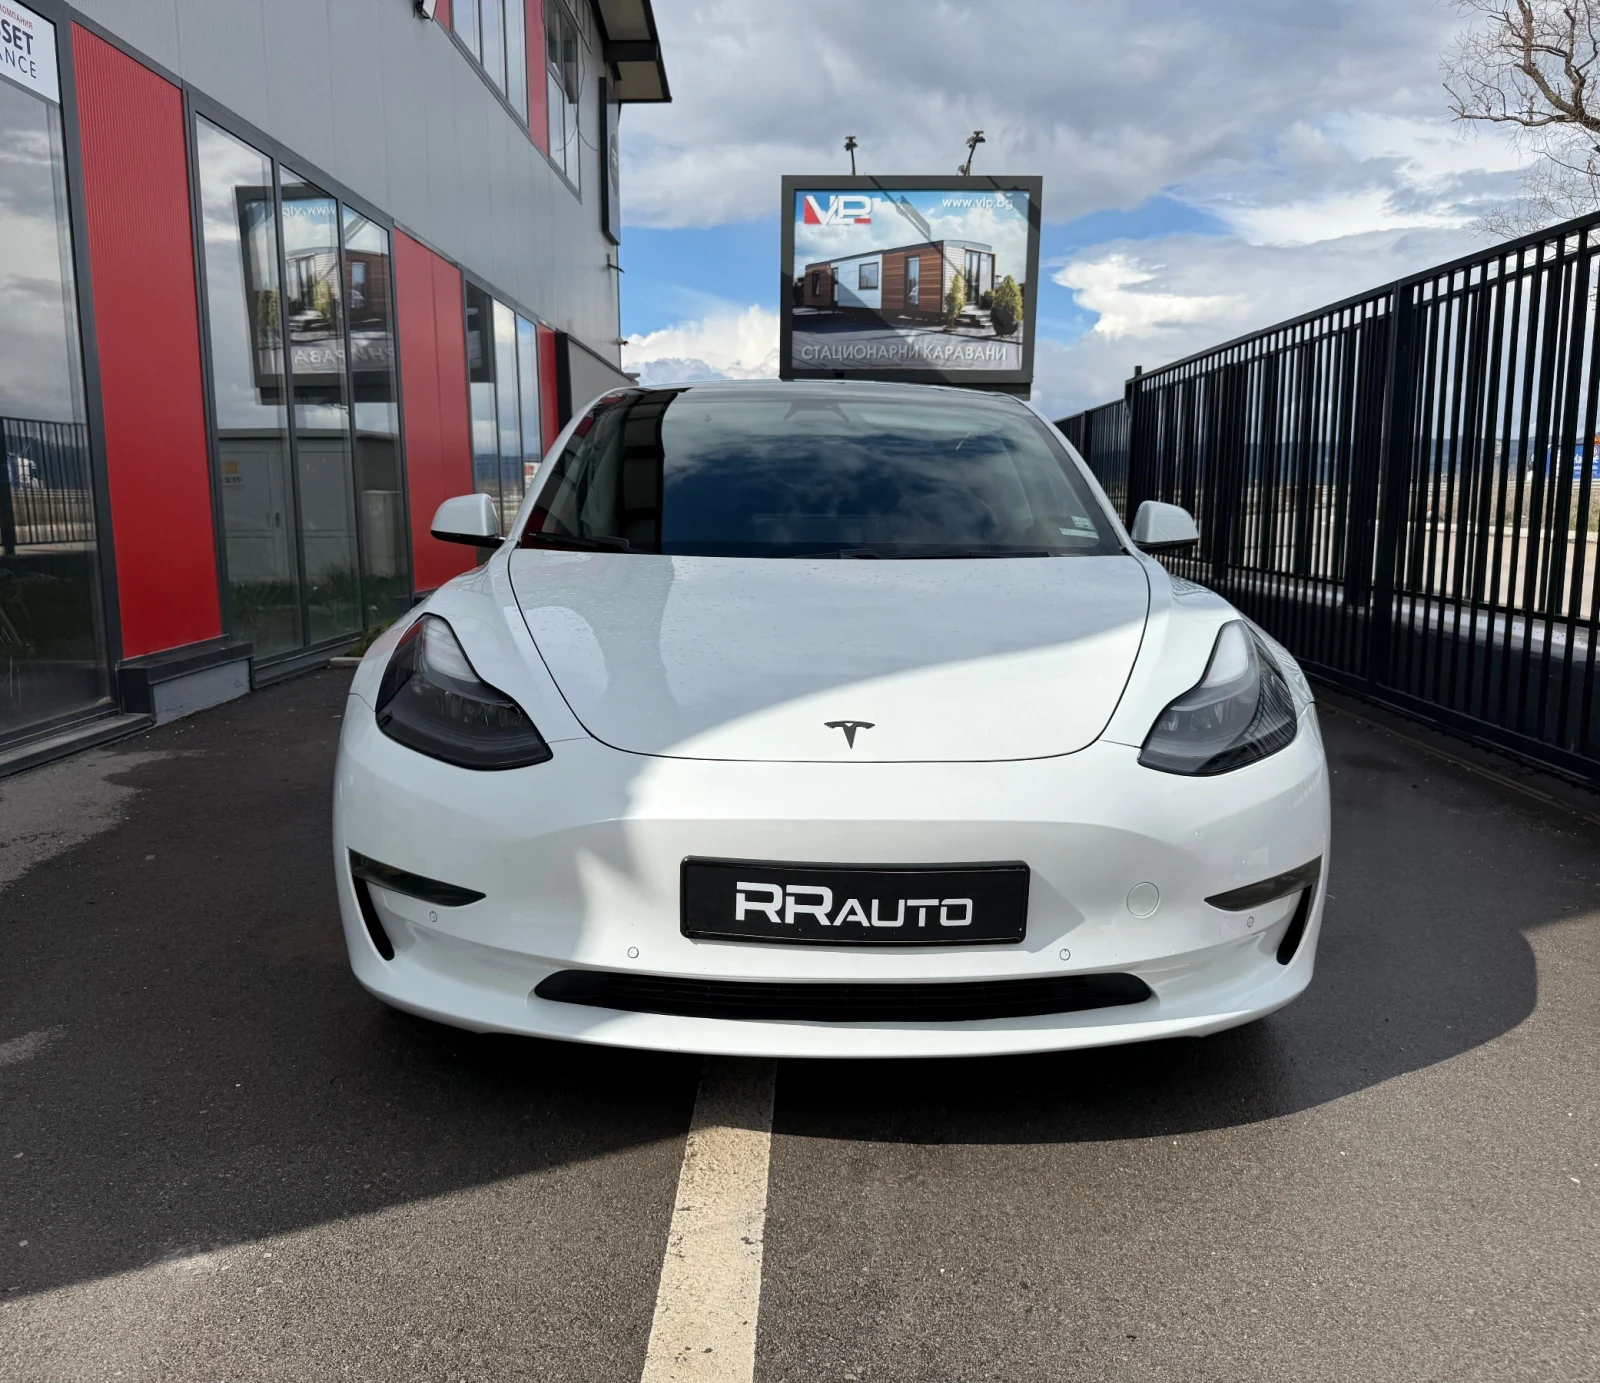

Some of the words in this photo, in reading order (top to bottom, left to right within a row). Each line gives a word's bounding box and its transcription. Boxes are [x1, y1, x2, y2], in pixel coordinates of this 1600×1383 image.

[0, 19, 34, 55] SET
[801, 345, 921, 361] СТАЦИОНАРНИ
[922, 345, 1007, 361] КАРАВАНИ
